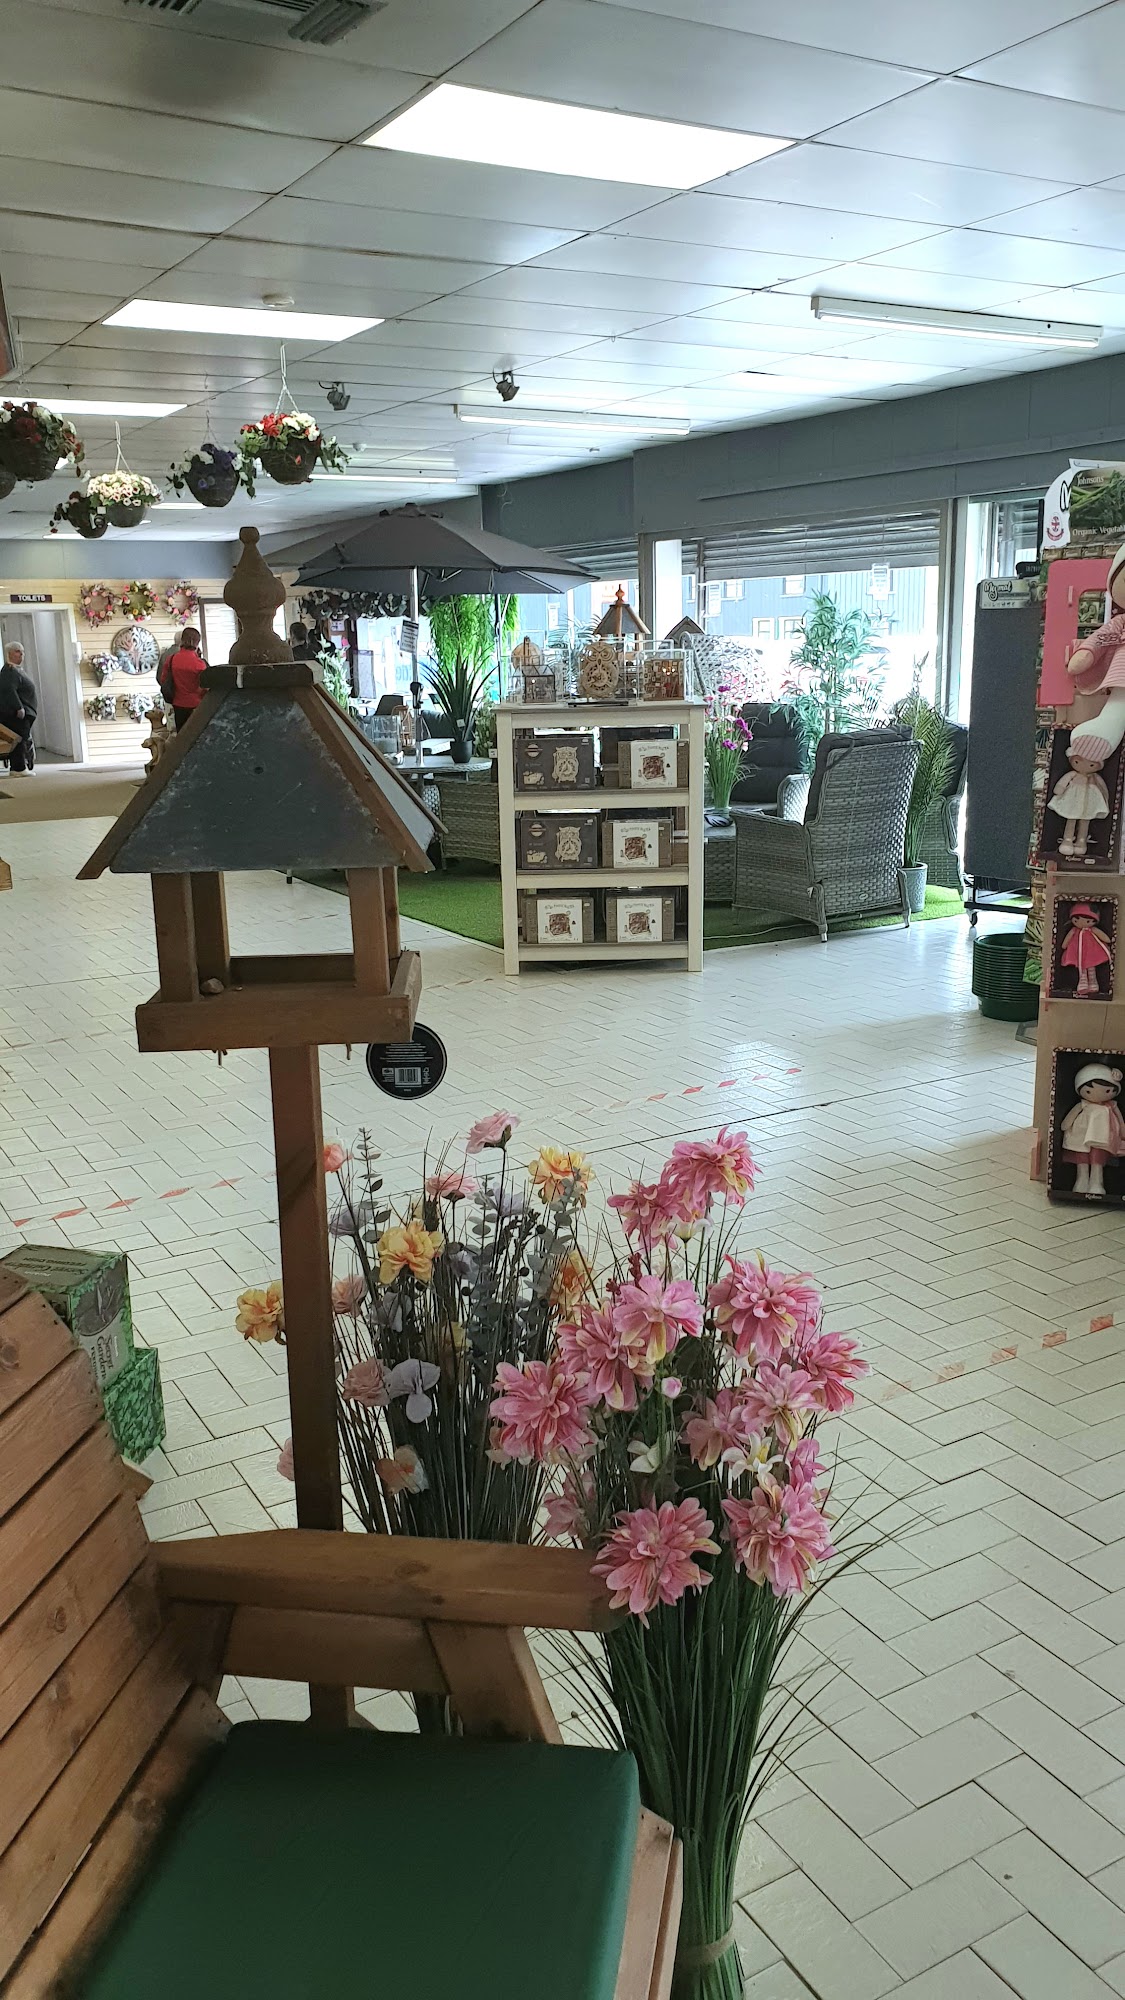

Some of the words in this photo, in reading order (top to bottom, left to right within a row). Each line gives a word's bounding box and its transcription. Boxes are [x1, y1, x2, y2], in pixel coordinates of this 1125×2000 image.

[1077, 473, 1104, 486] Johnsons
[1072, 526, 1098, 537] Organic
[103, 1334, 114, 1369] Secret
